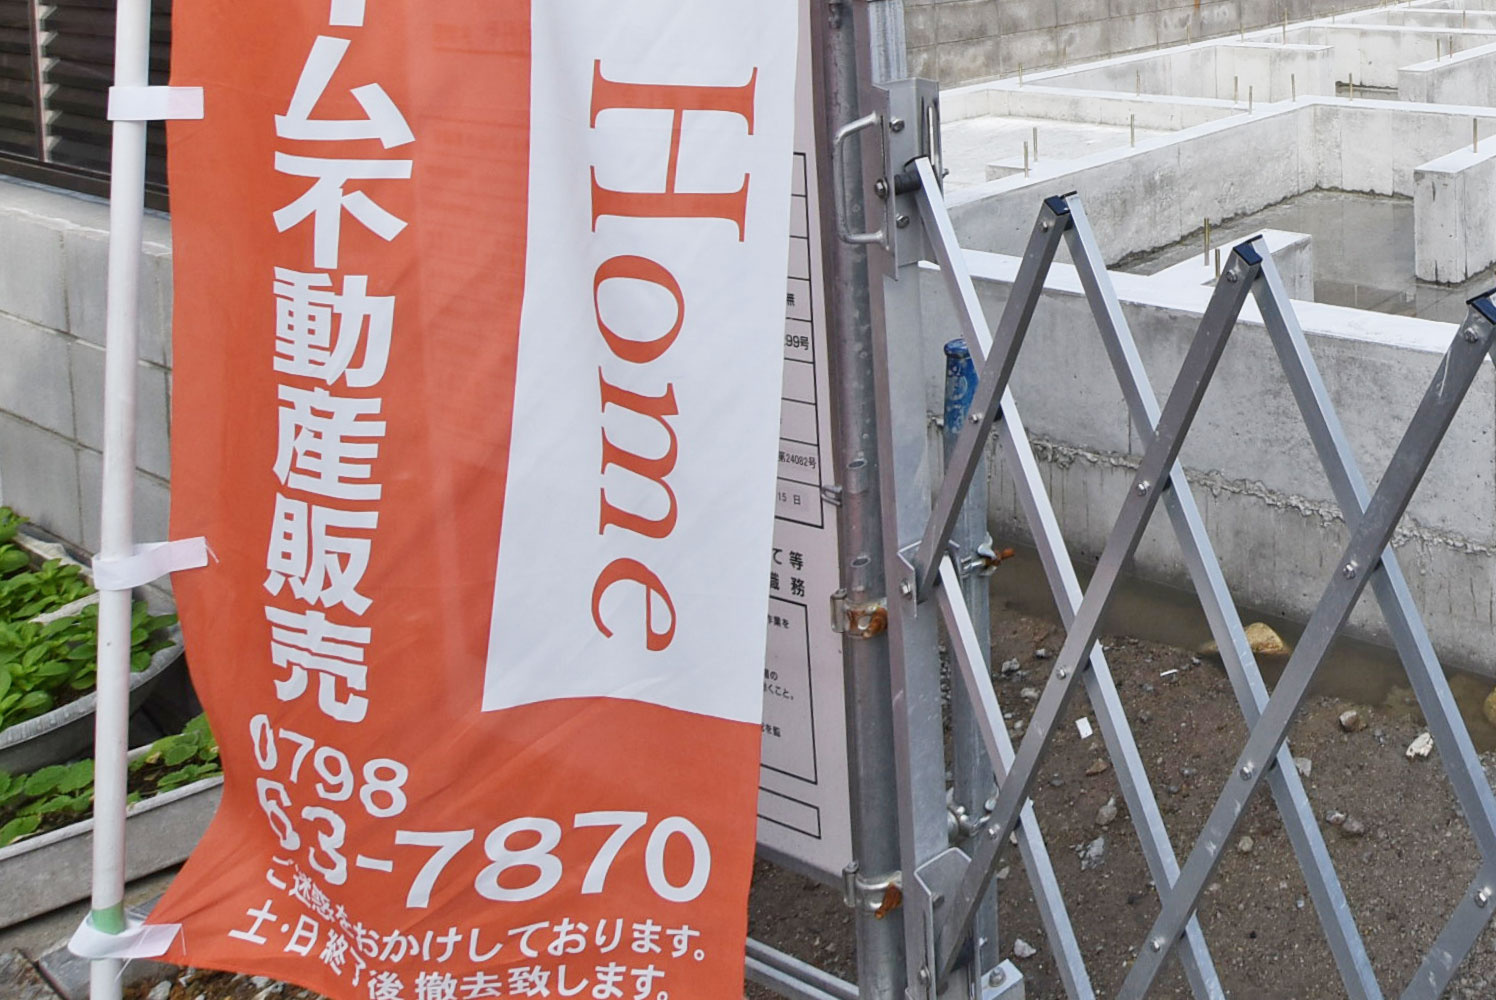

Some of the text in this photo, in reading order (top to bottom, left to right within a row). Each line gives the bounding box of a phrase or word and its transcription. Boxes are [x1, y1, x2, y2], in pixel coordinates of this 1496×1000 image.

[589, 57, 758, 652] Home
[763, 682, 794, 700] くこと。
[250, 714, 408, 819] 0798
[256, 778, 711, 908] 63-7870
[266, 856, 706, 963] ご迷惑をおかけしております。
